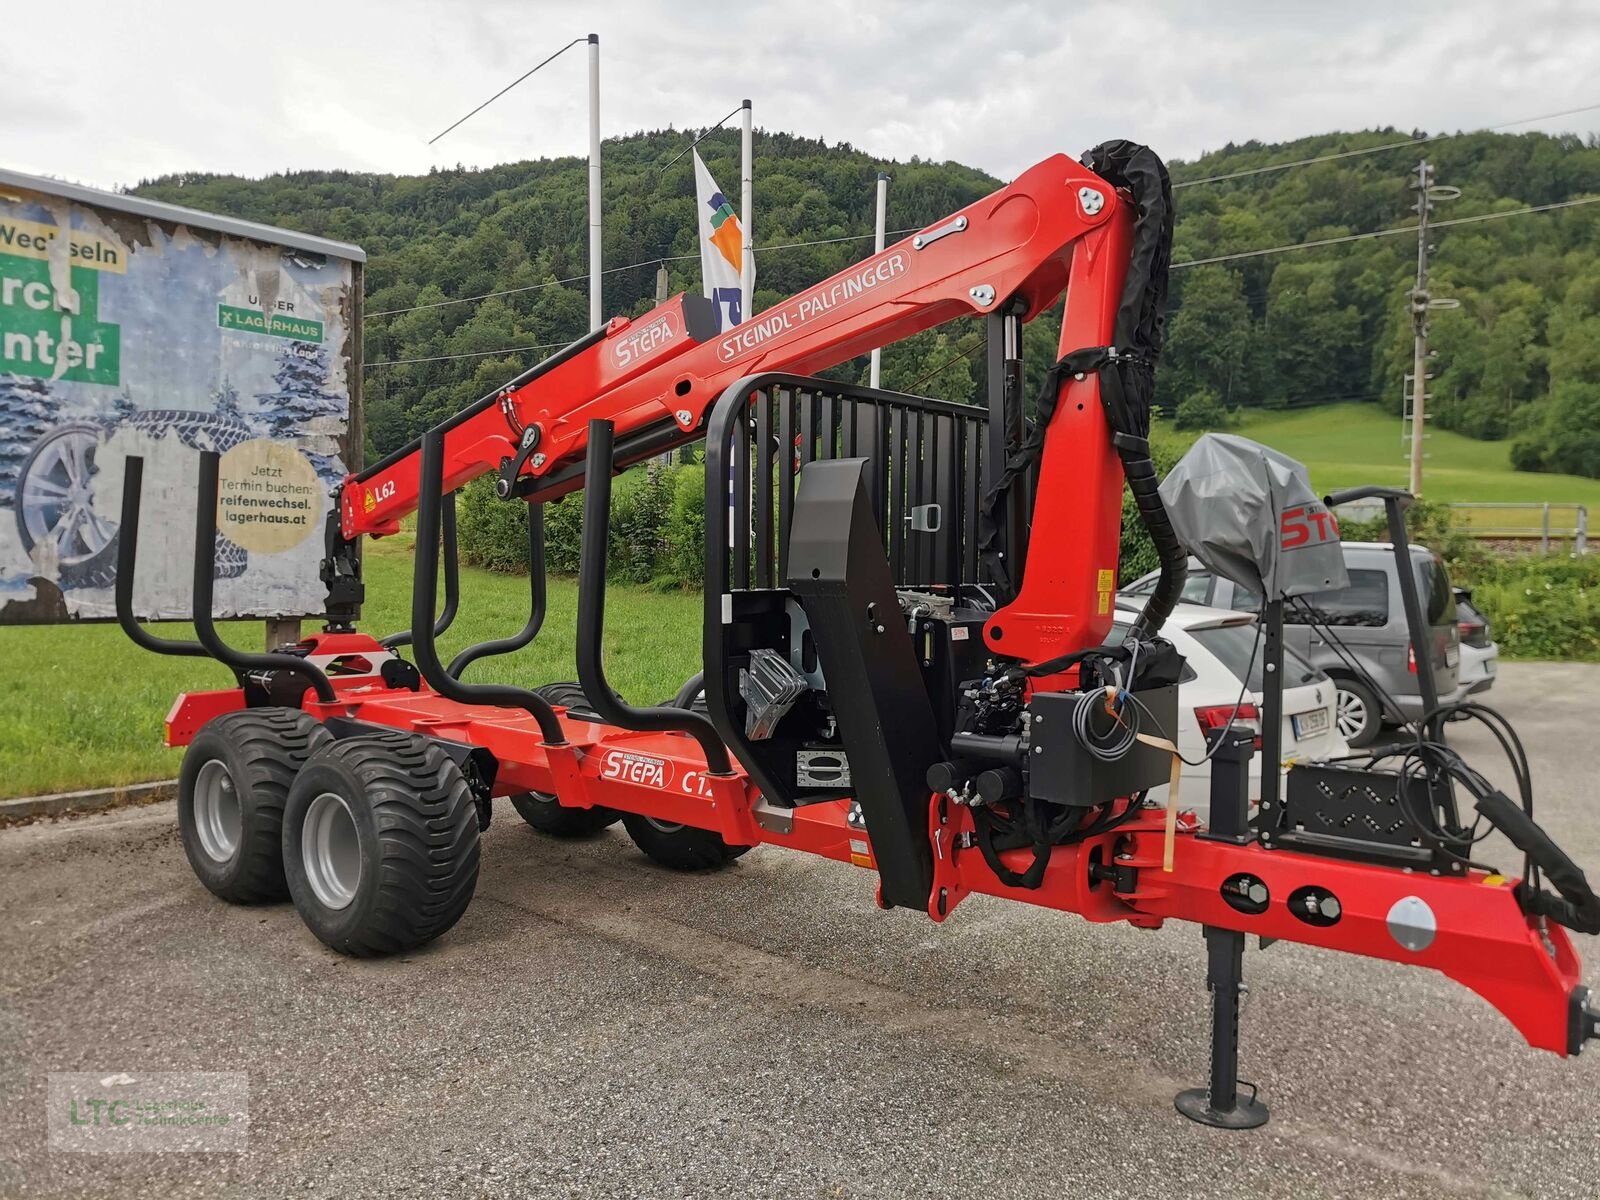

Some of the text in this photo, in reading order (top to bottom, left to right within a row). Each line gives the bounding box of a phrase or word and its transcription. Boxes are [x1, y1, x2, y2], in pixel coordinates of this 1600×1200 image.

[0, 224, 117, 264] Wecseln
[722, 254, 904, 359] STEINDL-PALFINGER
[615, 322, 673, 367] STEPA
[251, 465, 282, 477] Jetzt
[220, 478, 312, 494] Termin buchen:
[375, 480, 396, 503] L62
[220, 495, 311, 509] reifenwechsel.
[225, 510, 306, 524] lagerhaus.at
[604, 751, 664, 787] STEPA
